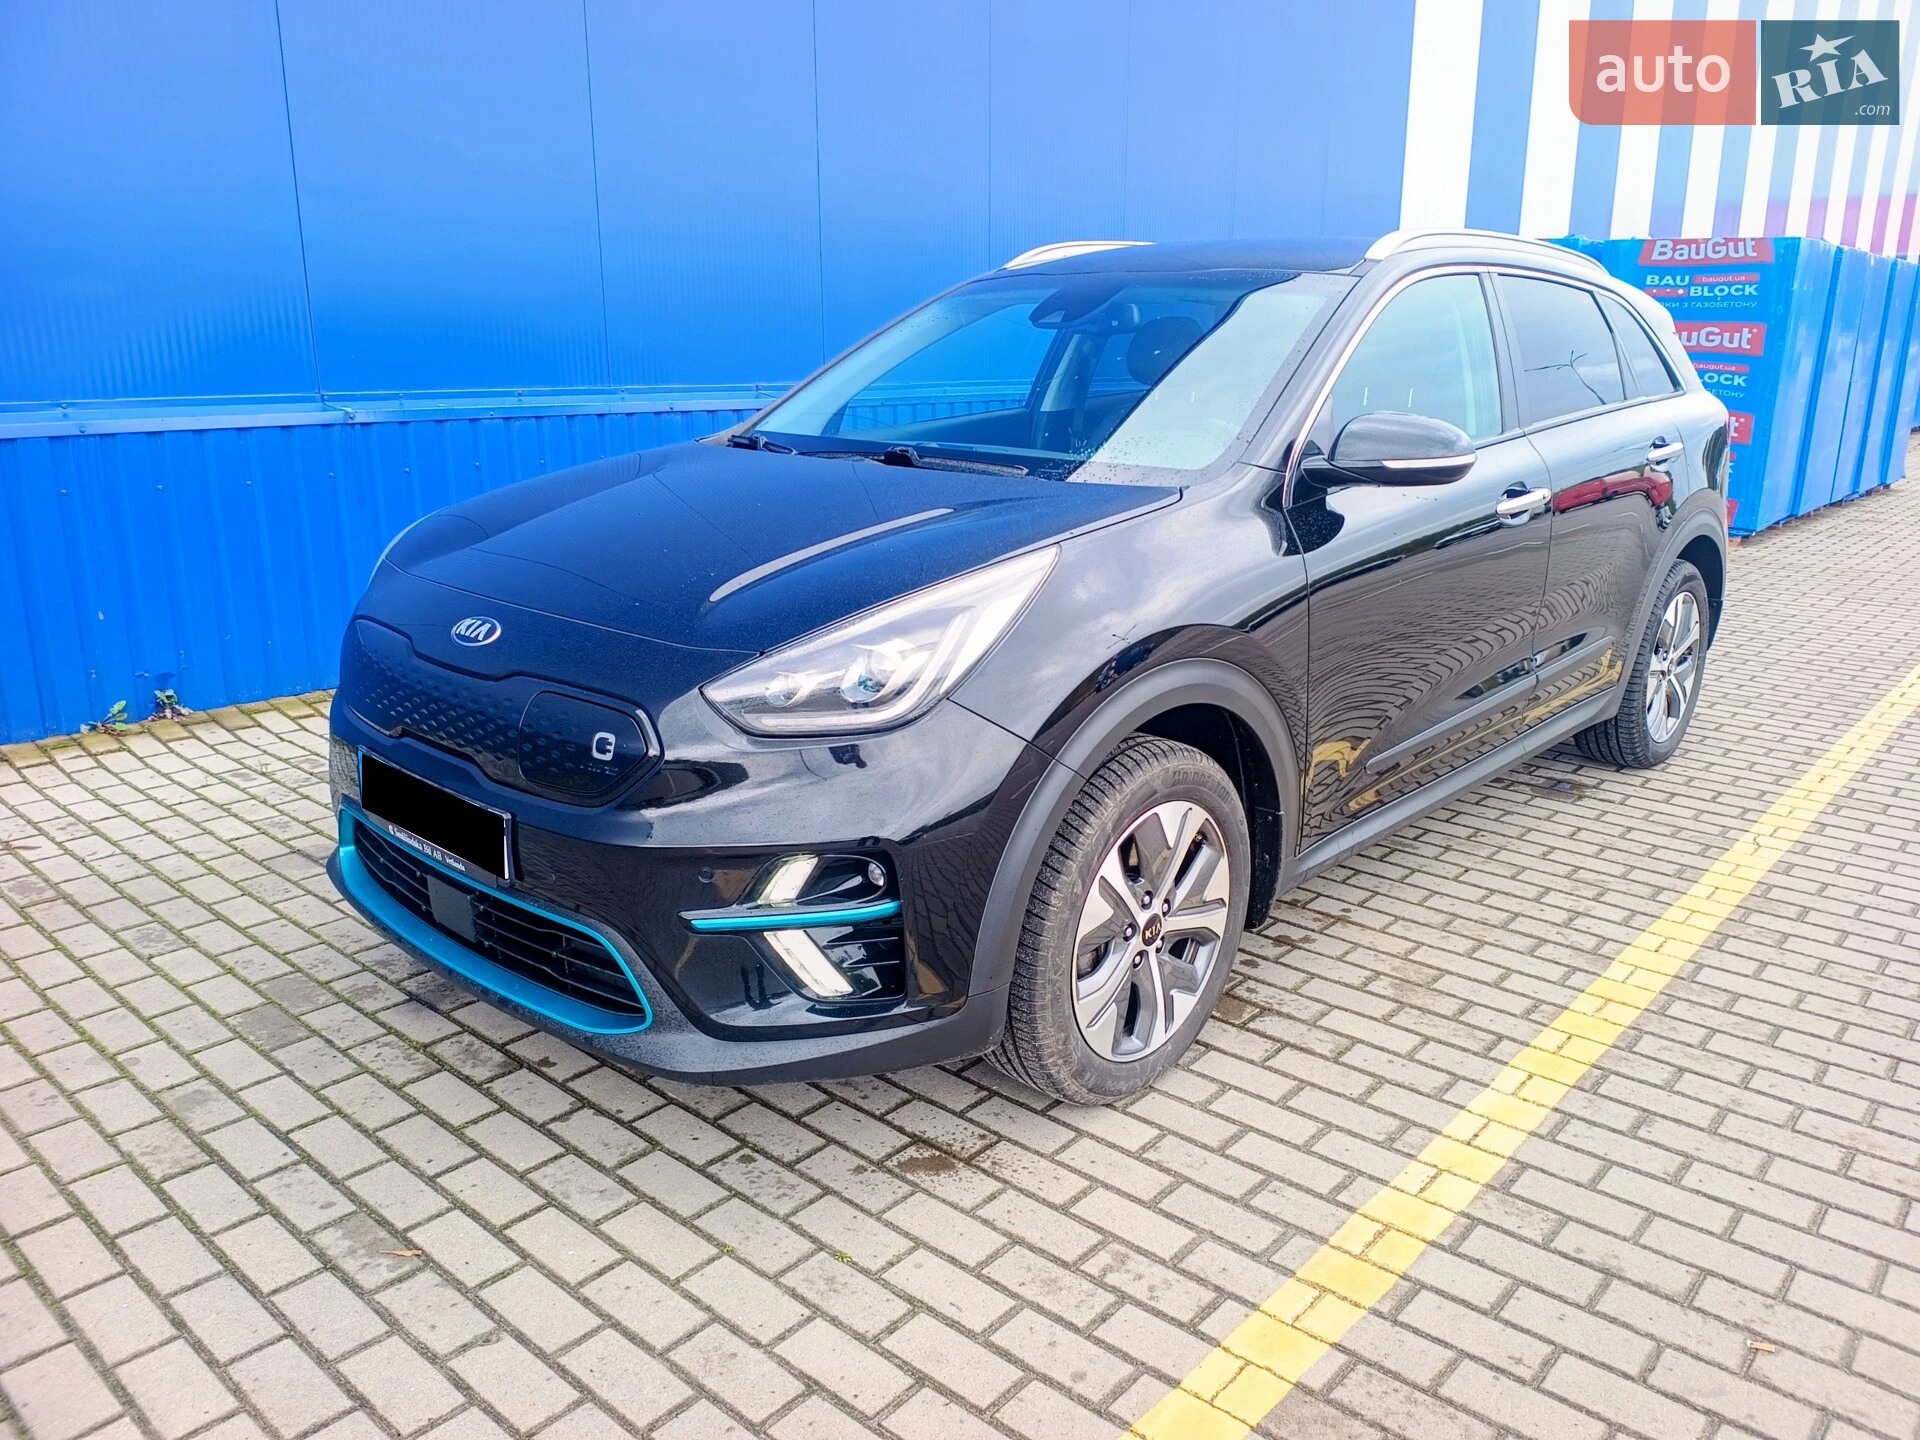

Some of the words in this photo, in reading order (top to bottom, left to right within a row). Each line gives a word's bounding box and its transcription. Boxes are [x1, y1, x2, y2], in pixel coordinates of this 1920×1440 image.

[1651, 237, 1758, 260] BauGut
[1645, 275, 1690, 286] BAU
[1702, 275, 1746, 283] baugut.ua
[1689, 284, 1759, 297] BLOCK
[1680, 327, 1752, 350] uGut
[1699, 372, 1748, 387] OCK
[455, 618, 492, 641] KIA
[1145, 922, 1161, 940] KIA
